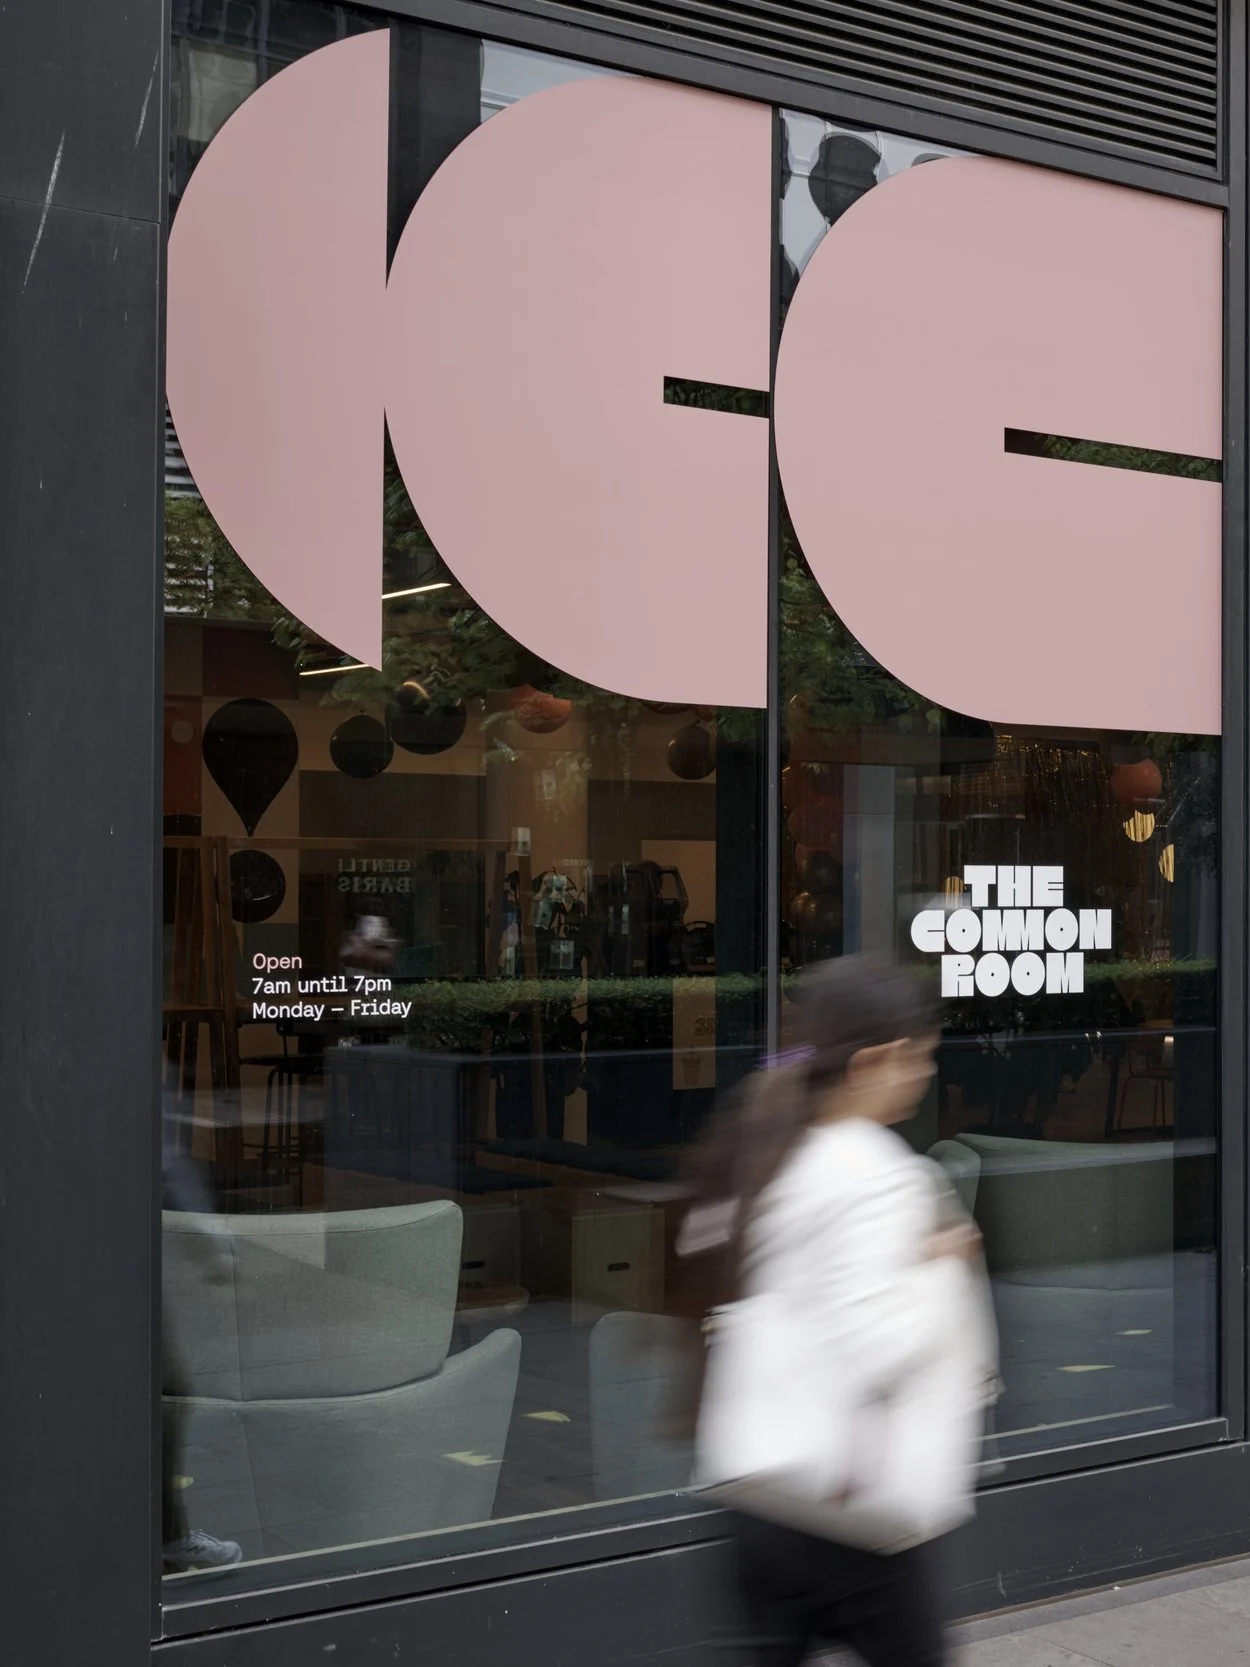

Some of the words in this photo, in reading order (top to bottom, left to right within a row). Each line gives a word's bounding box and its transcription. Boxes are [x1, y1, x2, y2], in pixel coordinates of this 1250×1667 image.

[963, 864, 1064, 907] THE
[910, 908, 1112, 953] COMMON
[252, 952, 303, 974] Open
[941, 951, 1085, 998] ROOM
[252, 977, 291, 995] 7am
[297, 975, 349, 994] until
[353, 975, 392, 996] 7pm
[252, 1001, 325, 1022] Monday
[350, 998, 412, 1019] Friday
